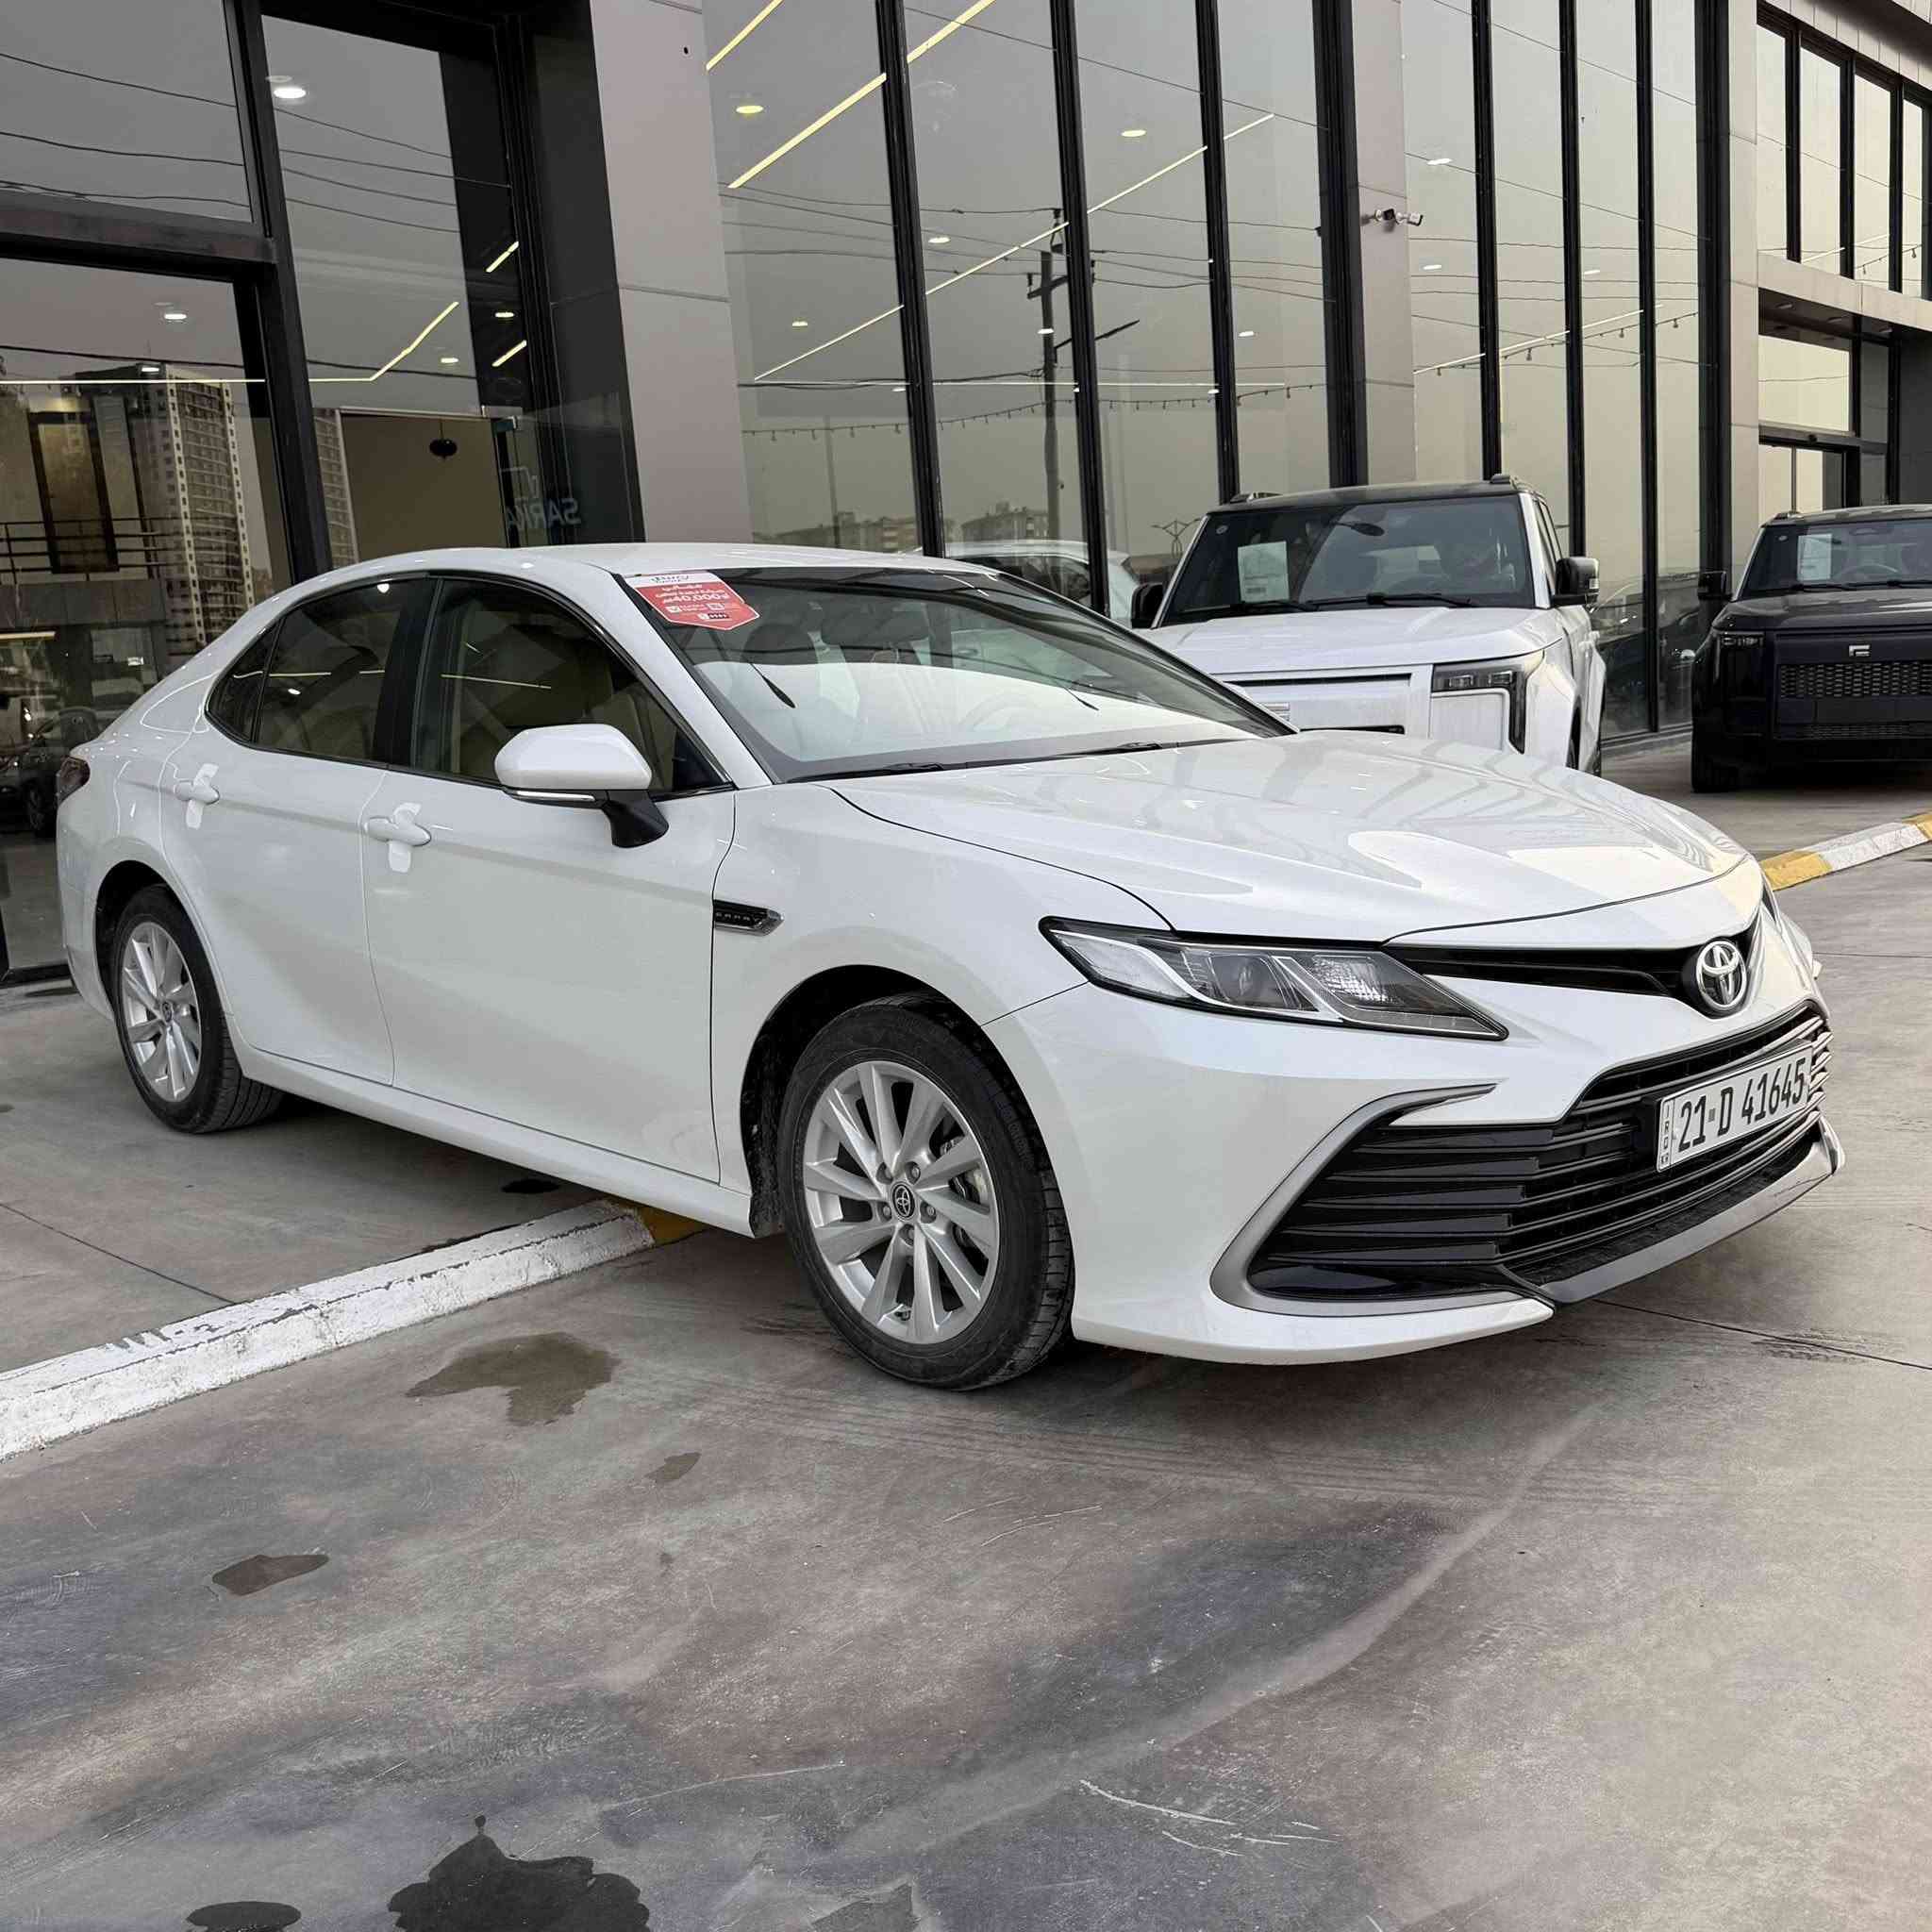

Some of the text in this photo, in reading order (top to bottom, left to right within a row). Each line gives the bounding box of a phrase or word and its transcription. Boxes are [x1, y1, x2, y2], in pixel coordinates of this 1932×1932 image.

[1678, 1058, 1806, 1152] 21 D 41645
